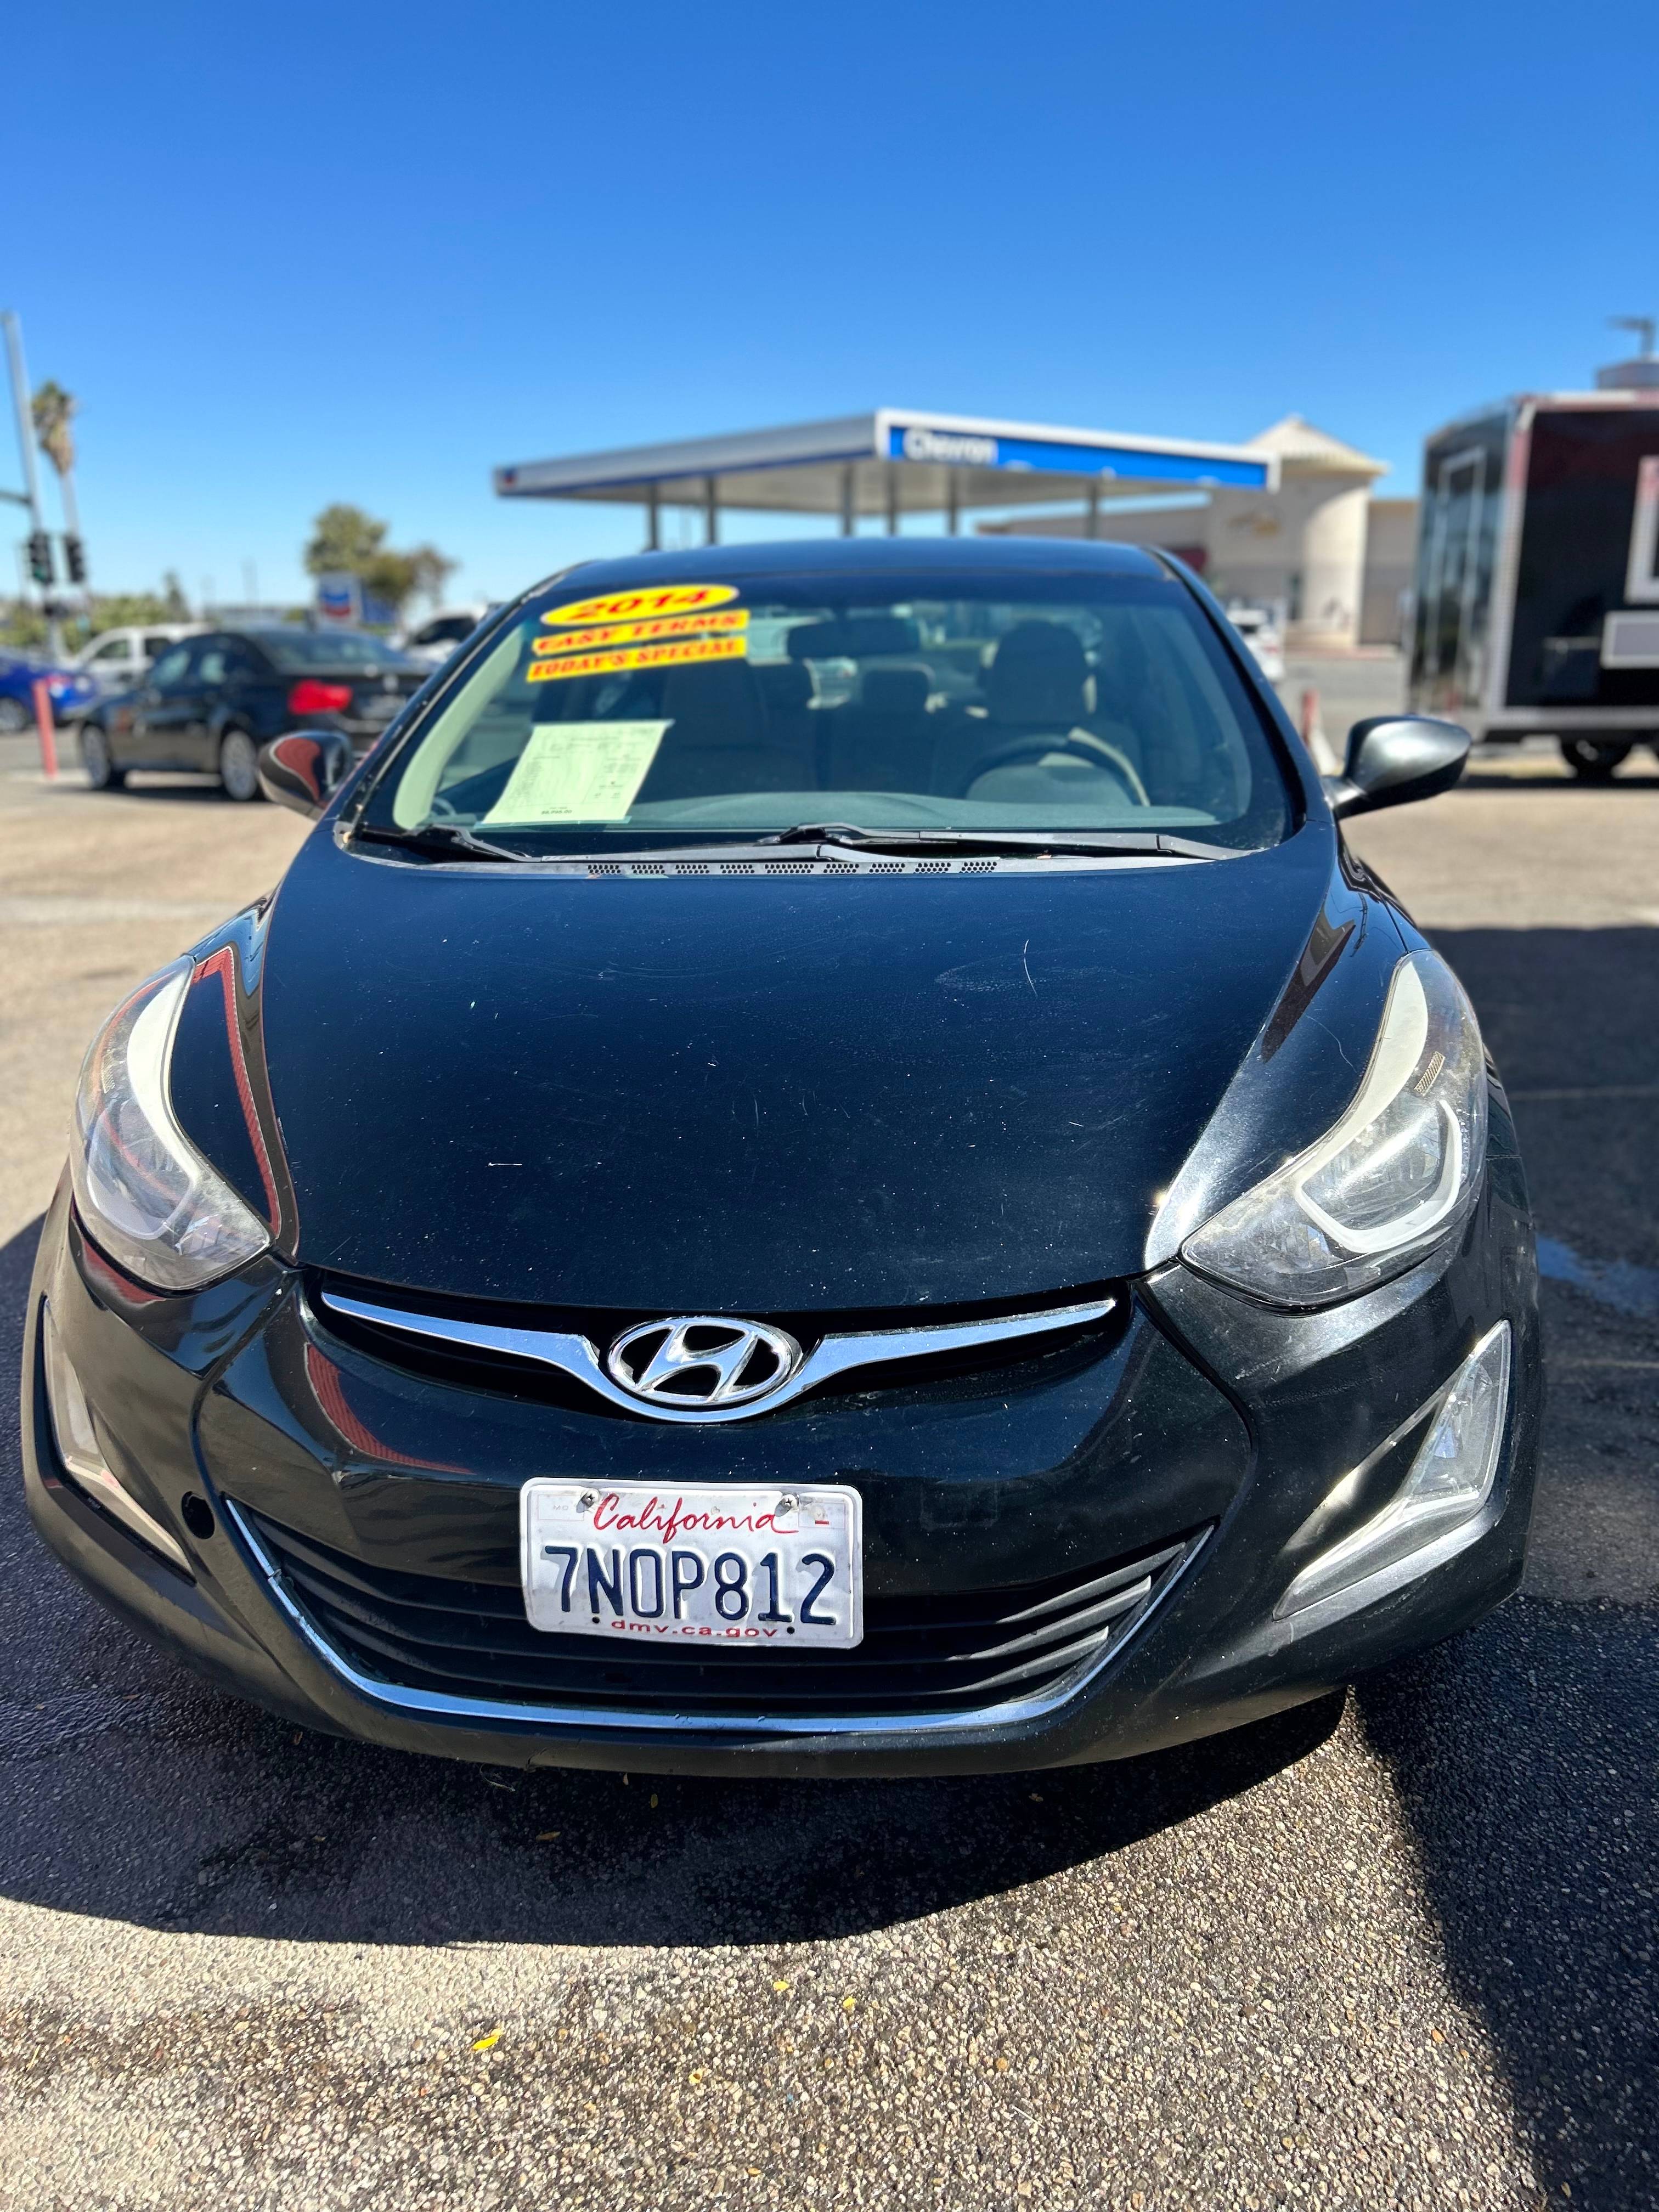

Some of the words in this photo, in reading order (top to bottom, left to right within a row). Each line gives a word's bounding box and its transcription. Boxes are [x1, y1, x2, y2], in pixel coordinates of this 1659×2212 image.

[567, 589, 710, 620] 2014
[538, 629, 613, 651] EASY
[632, 615, 740, 637] TERMS
[636, 641, 735, 663] SPECIAL
[594, 1493, 798, 1544] California
[545, 1545, 837, 1626] 7NOP812
[611, 1619, 778, 1638] dmv.ca.gov
